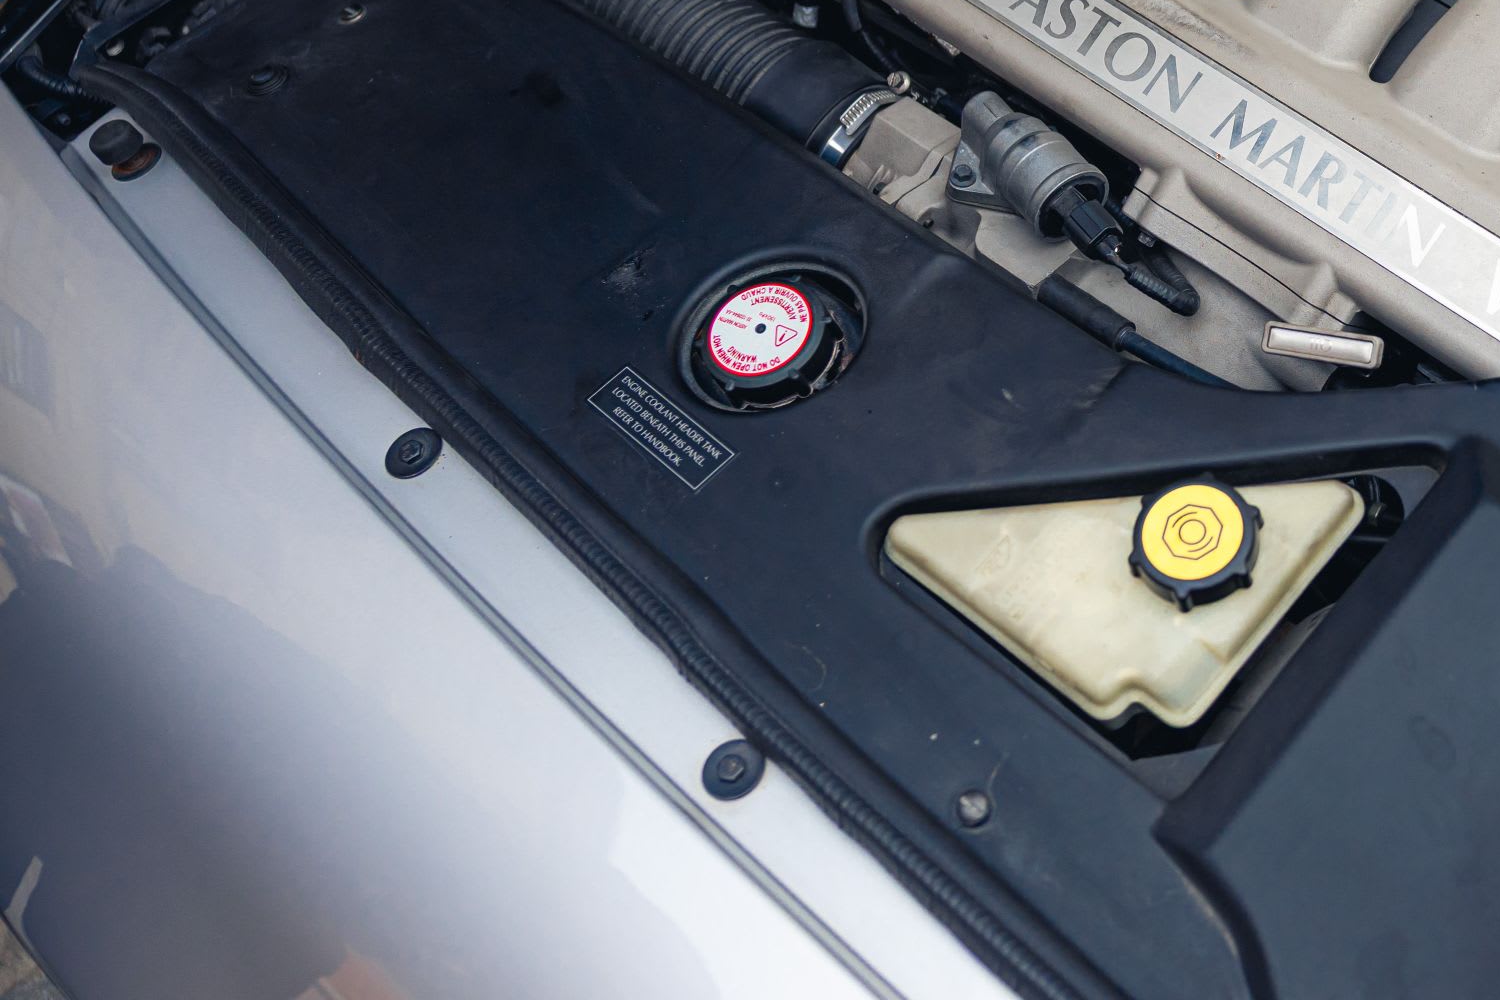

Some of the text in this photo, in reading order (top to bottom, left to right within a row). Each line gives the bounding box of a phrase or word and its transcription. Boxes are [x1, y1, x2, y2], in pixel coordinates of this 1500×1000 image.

[1209, 98, 1446, 269] MARTIN
[740, 287, 766, 301] CHAUD
[774, 286, 799, 302] OUVRIR
[751, 295, 797, 320] AVERTISSEMENT
[795, 300, 805, 314] PAS
[800, 314, 808, 323] NE
[713, 334, 781, 372] DO NOT OPEN WHEN HOT
[727, 345, 757, 363] WARNING
[612, 406, 634, 425] REFER
[631, 421, 643, 433] TO
[612, 387, 706, 467] LOCATED BENEATH THIS PANEL.
[621, 375, 723, 460] ENGINE COOLANT HEADER TANK
